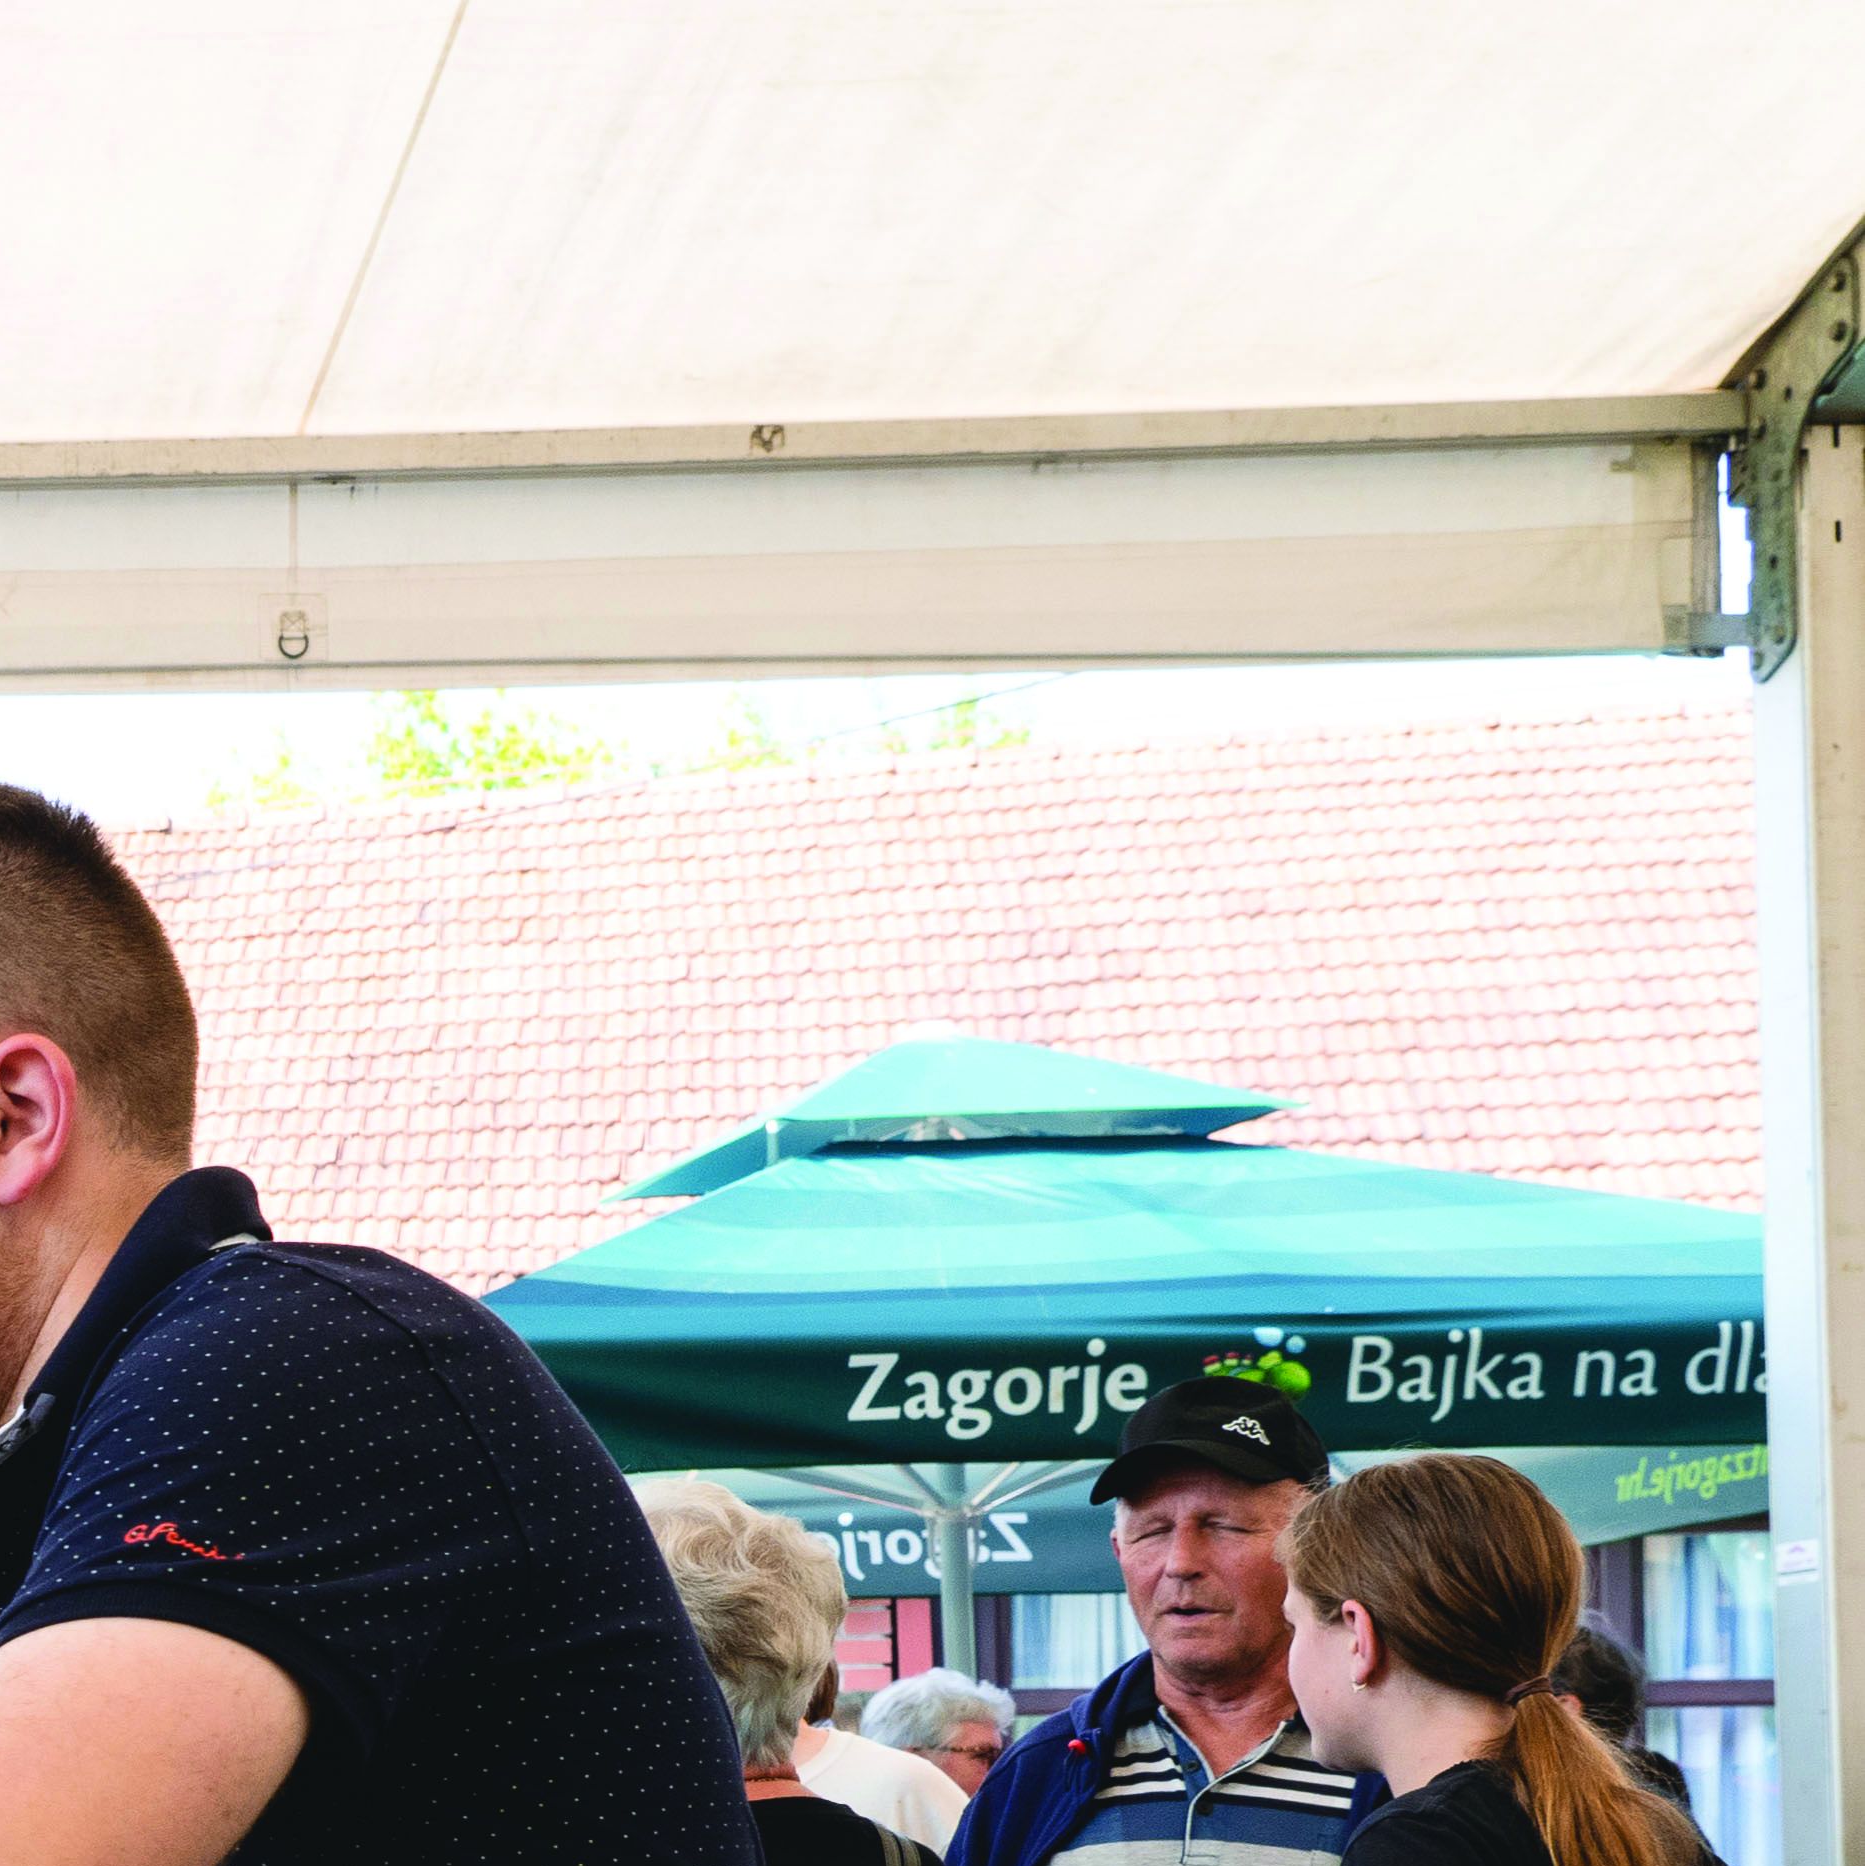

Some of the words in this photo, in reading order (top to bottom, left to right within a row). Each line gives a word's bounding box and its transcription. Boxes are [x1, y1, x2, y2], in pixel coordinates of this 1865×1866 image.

[847, 1338, 1149, 1440] Zagorje
[1346, 1326, 1546, 1423] Bajka
[1573, 1348, 1659, 1398] na
